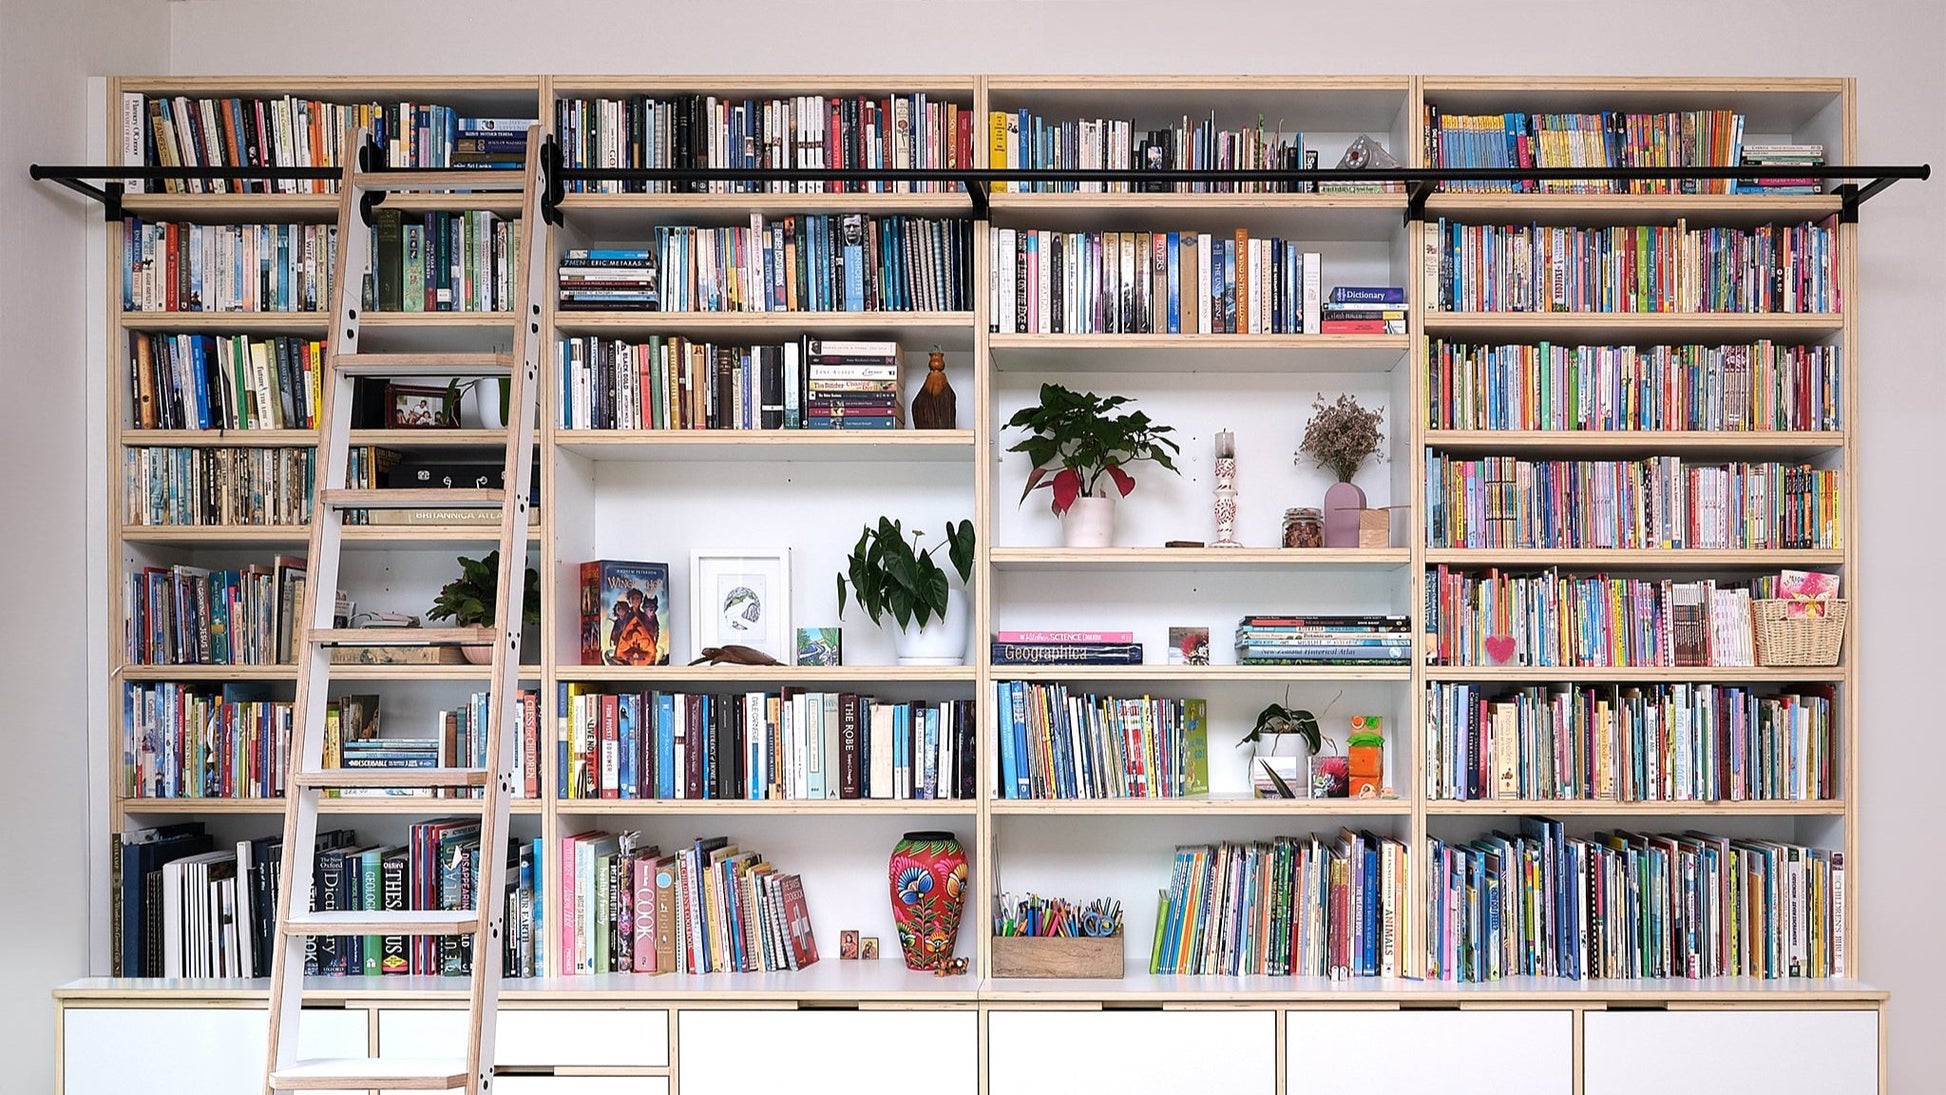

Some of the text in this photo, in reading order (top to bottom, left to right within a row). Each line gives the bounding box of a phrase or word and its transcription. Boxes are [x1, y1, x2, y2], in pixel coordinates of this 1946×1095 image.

[1156, 239, 1165, 270] RIVERS
[854, 247, 862, 297] BONHOEFFER
[1018, 264, 1027, 278] LIFE
[1018, 291, 1027, 304] THE
[1347, 290, 1385, 300] Dictionary
[1018, 305, 1027, 324] EDGE
[416, 512, 503, 520] BRITANNICA ATLA
[198, 587, 206, 616] GROWING
[200, 627, 209, 649] JESUS
[1050, 632, 1082, 641] SCIENCE
[1005, 644, 1088, 662] Geographica
[1304, 648, 1337, 656] Historical
[1338, 648, 1357, 656] Atlas
[525, 700, 533, 726] CHESS
[846, 701, 854, 722] THE
[587, 722, 595, 739] LIVE
[842, 724, 854, 751] ROBE
[527, 737, 537, 780] CHILDREN
[587, 740, 595, 755] NOT
[587, 769, 595, 785] LIES
[320, 861, 343, 869] Oxford
[598, 866, 607, 926] healthy family
[681, 868, 693, 950] CHILDREN'S COOKBOOK
[322, 873, 339, 955] Dictiry
[385, 869, 402, 953] THESUS
[521, 889, 530, 943] OUR EARTH
[636, 888, 654, 942] COOK
[1835, 880, 1843, 960] CHILDREN'S BIBLE
[1385, 909, 1394, 956] ANIMALS
[305, 935, 316, 962] OOK
